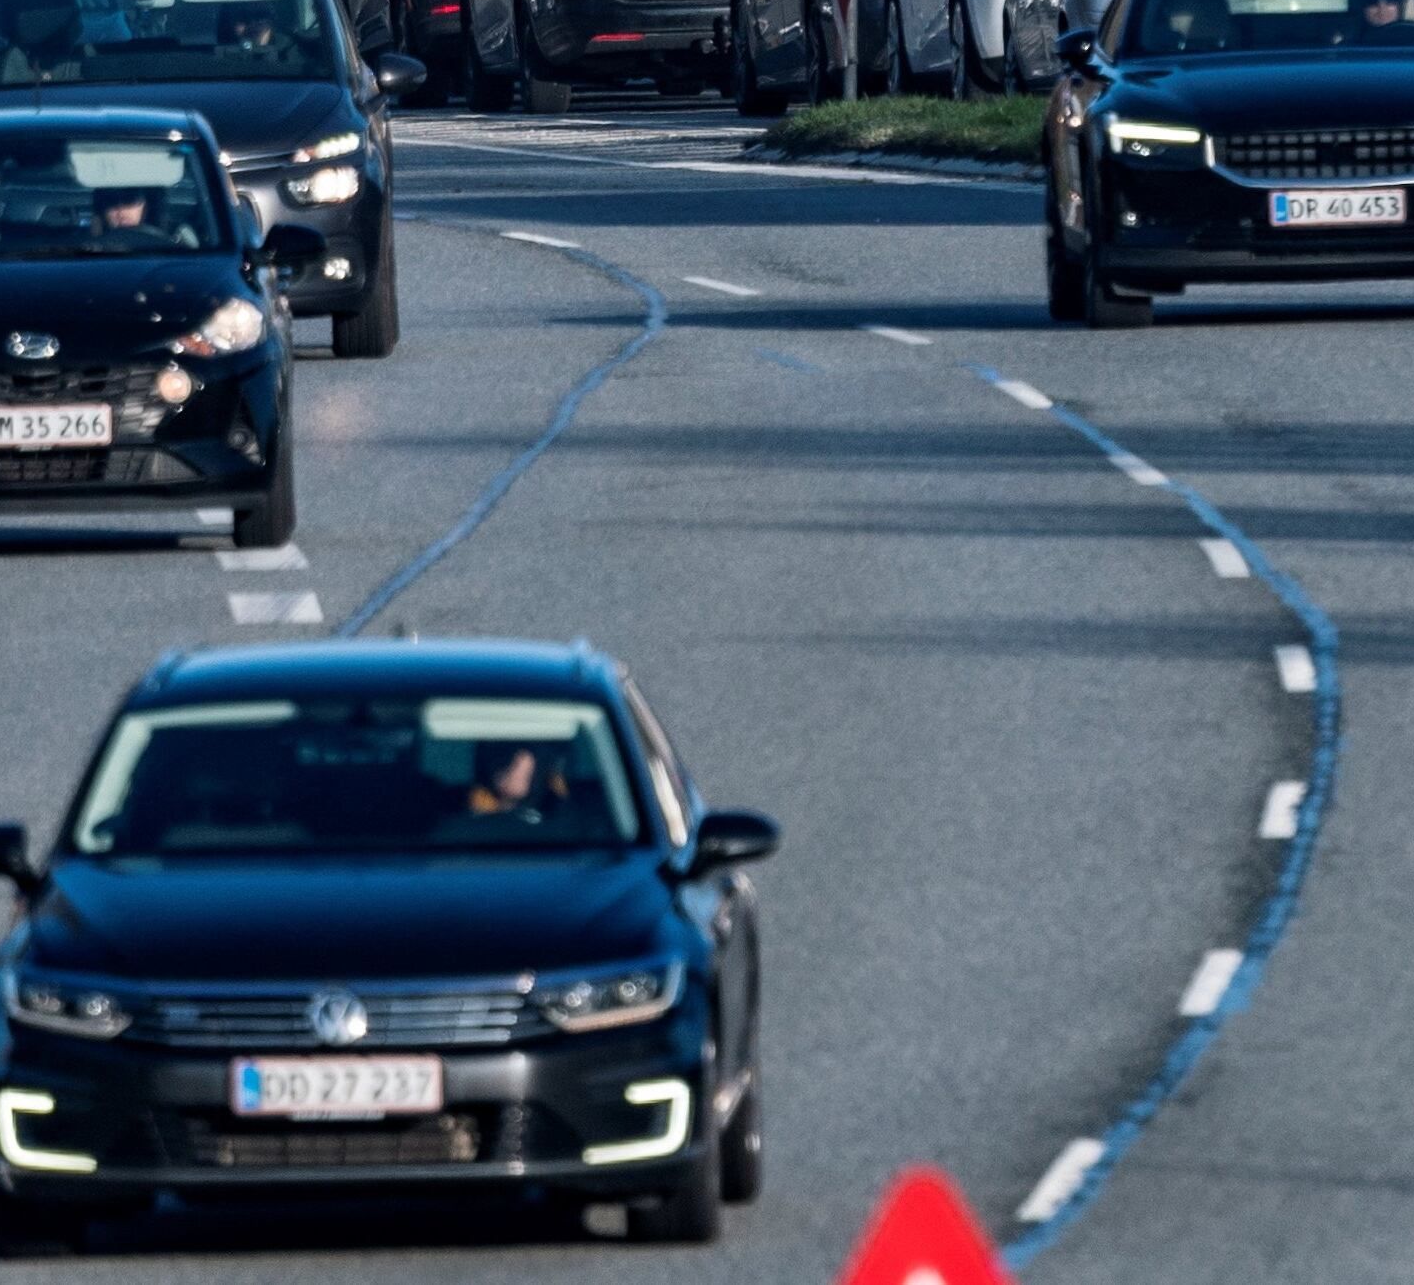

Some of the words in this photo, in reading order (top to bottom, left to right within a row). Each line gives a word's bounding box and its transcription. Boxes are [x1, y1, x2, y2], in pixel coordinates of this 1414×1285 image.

[1289, 198, 1318, 219] DR
[1327, 197, 1353, 218] 40
[1359, 196, 1401, 217] 453
[21, 416, 50, 439] 35
[59, 414, 106, 438] 266
[265, 1071, 310, 1104] DD
[321, 1070, 359, 1103] 27
[371, 1068, 432, 1102] 237
